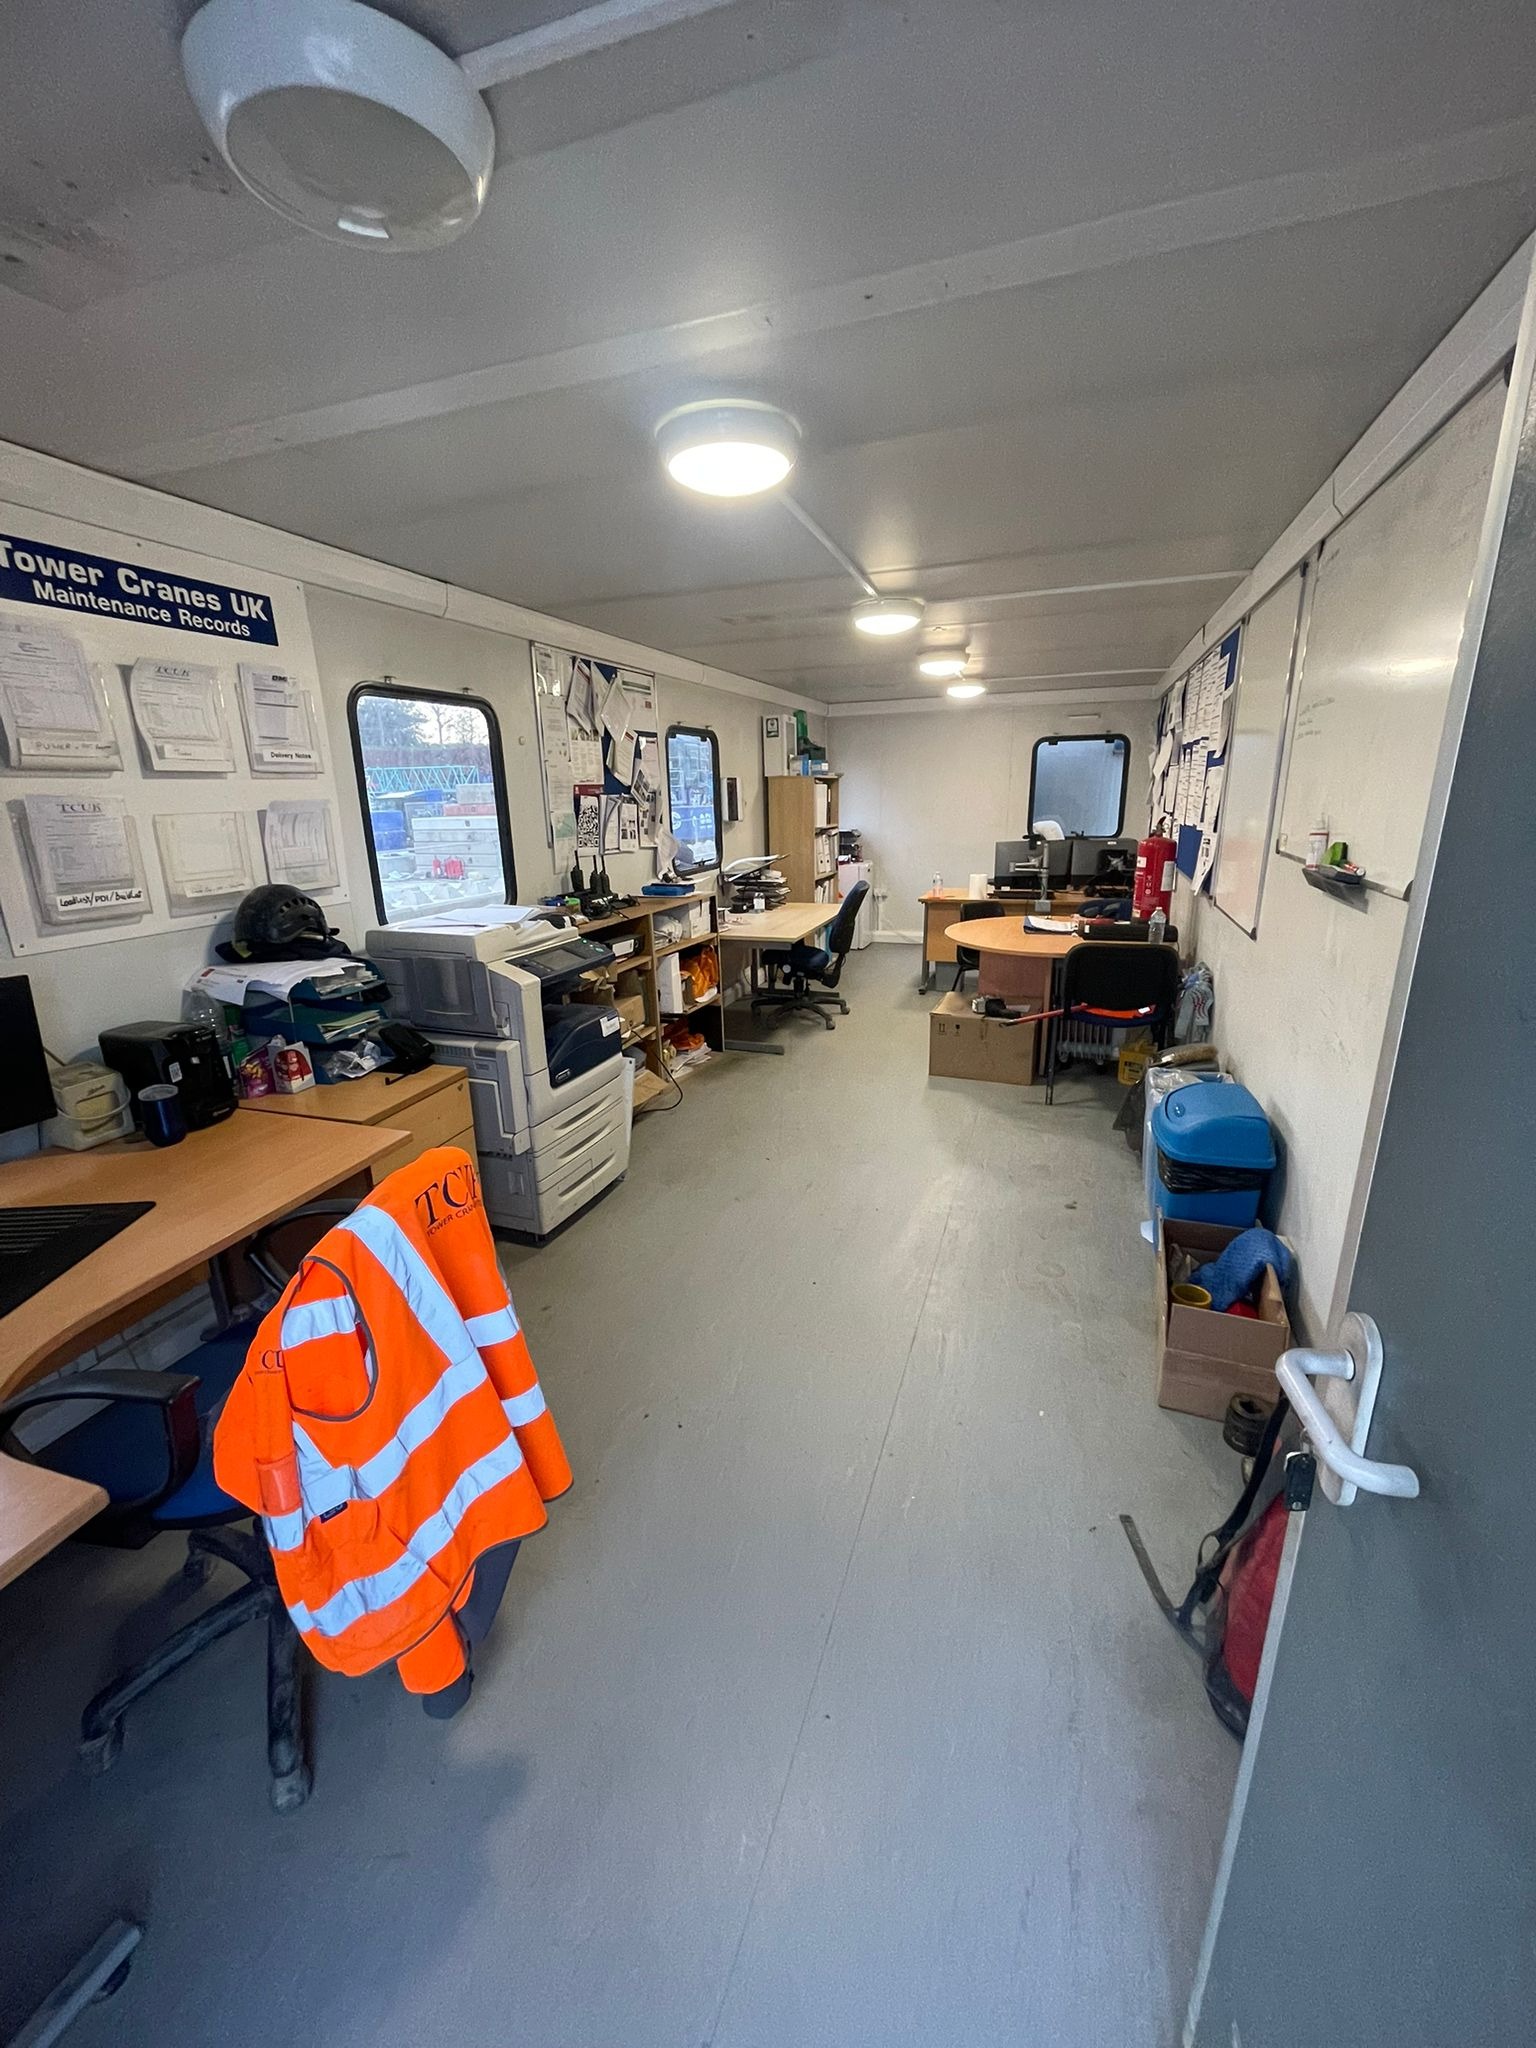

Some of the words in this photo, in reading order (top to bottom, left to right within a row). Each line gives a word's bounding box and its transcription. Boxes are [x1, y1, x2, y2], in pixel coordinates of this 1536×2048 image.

[0, 540, 104, 587] Tower
[117, 567, 222, 612] Cranes
[230, 592, 269, 622] UK
[32, 579, 172, 623] Maintenance
[179, 610, 251, 637] Records
[270, 751, 294, 760] Delivery
[426, 1214, 454, 1238] TOWER
